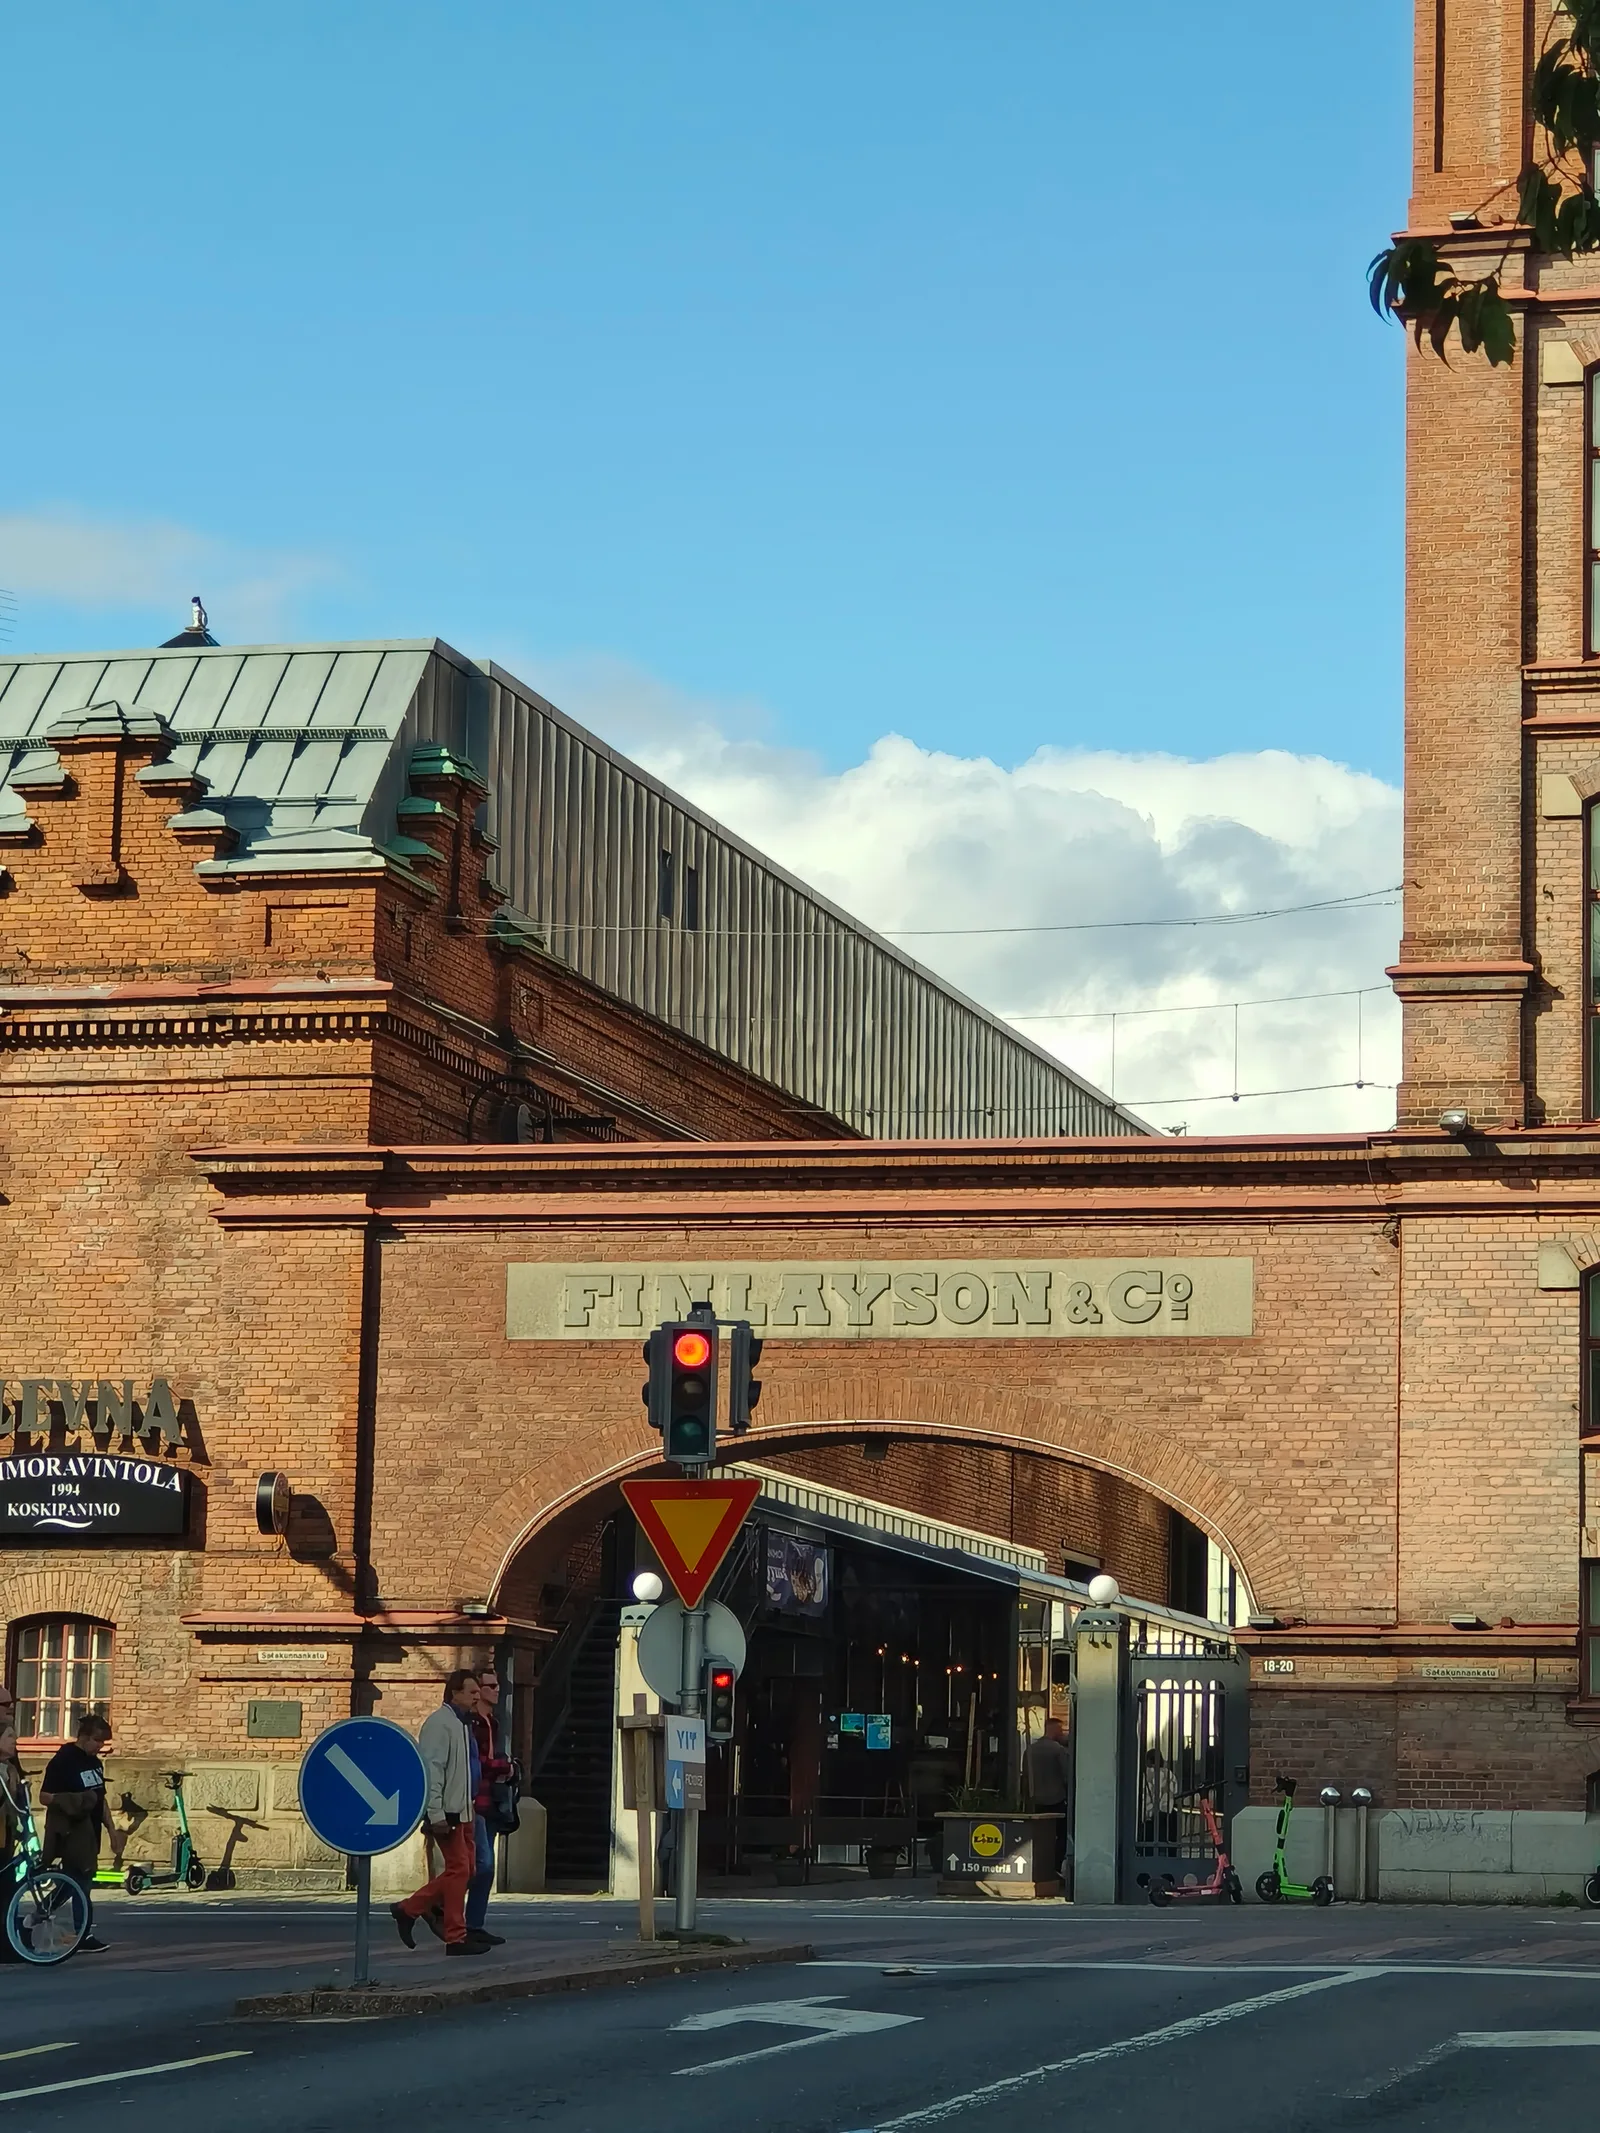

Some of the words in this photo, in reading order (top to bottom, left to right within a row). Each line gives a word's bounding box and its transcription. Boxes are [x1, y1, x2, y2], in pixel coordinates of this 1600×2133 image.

[564, 1270, 1053, 1328] FINLAYSON
[51, 1482, 81, 1497] 1994
[7, 1502, 121, 1517] KOSKIPANIMO
[261, 1651, 326, 1660] Satakunnankatu
[1262, 1660, 1294, 1672] 18-20
[1425, 1667, 1497, 1677] Satakunnankatu
[676, 1729, 697, 1751] YIT
[961, 1863, 980, 1873] 150
